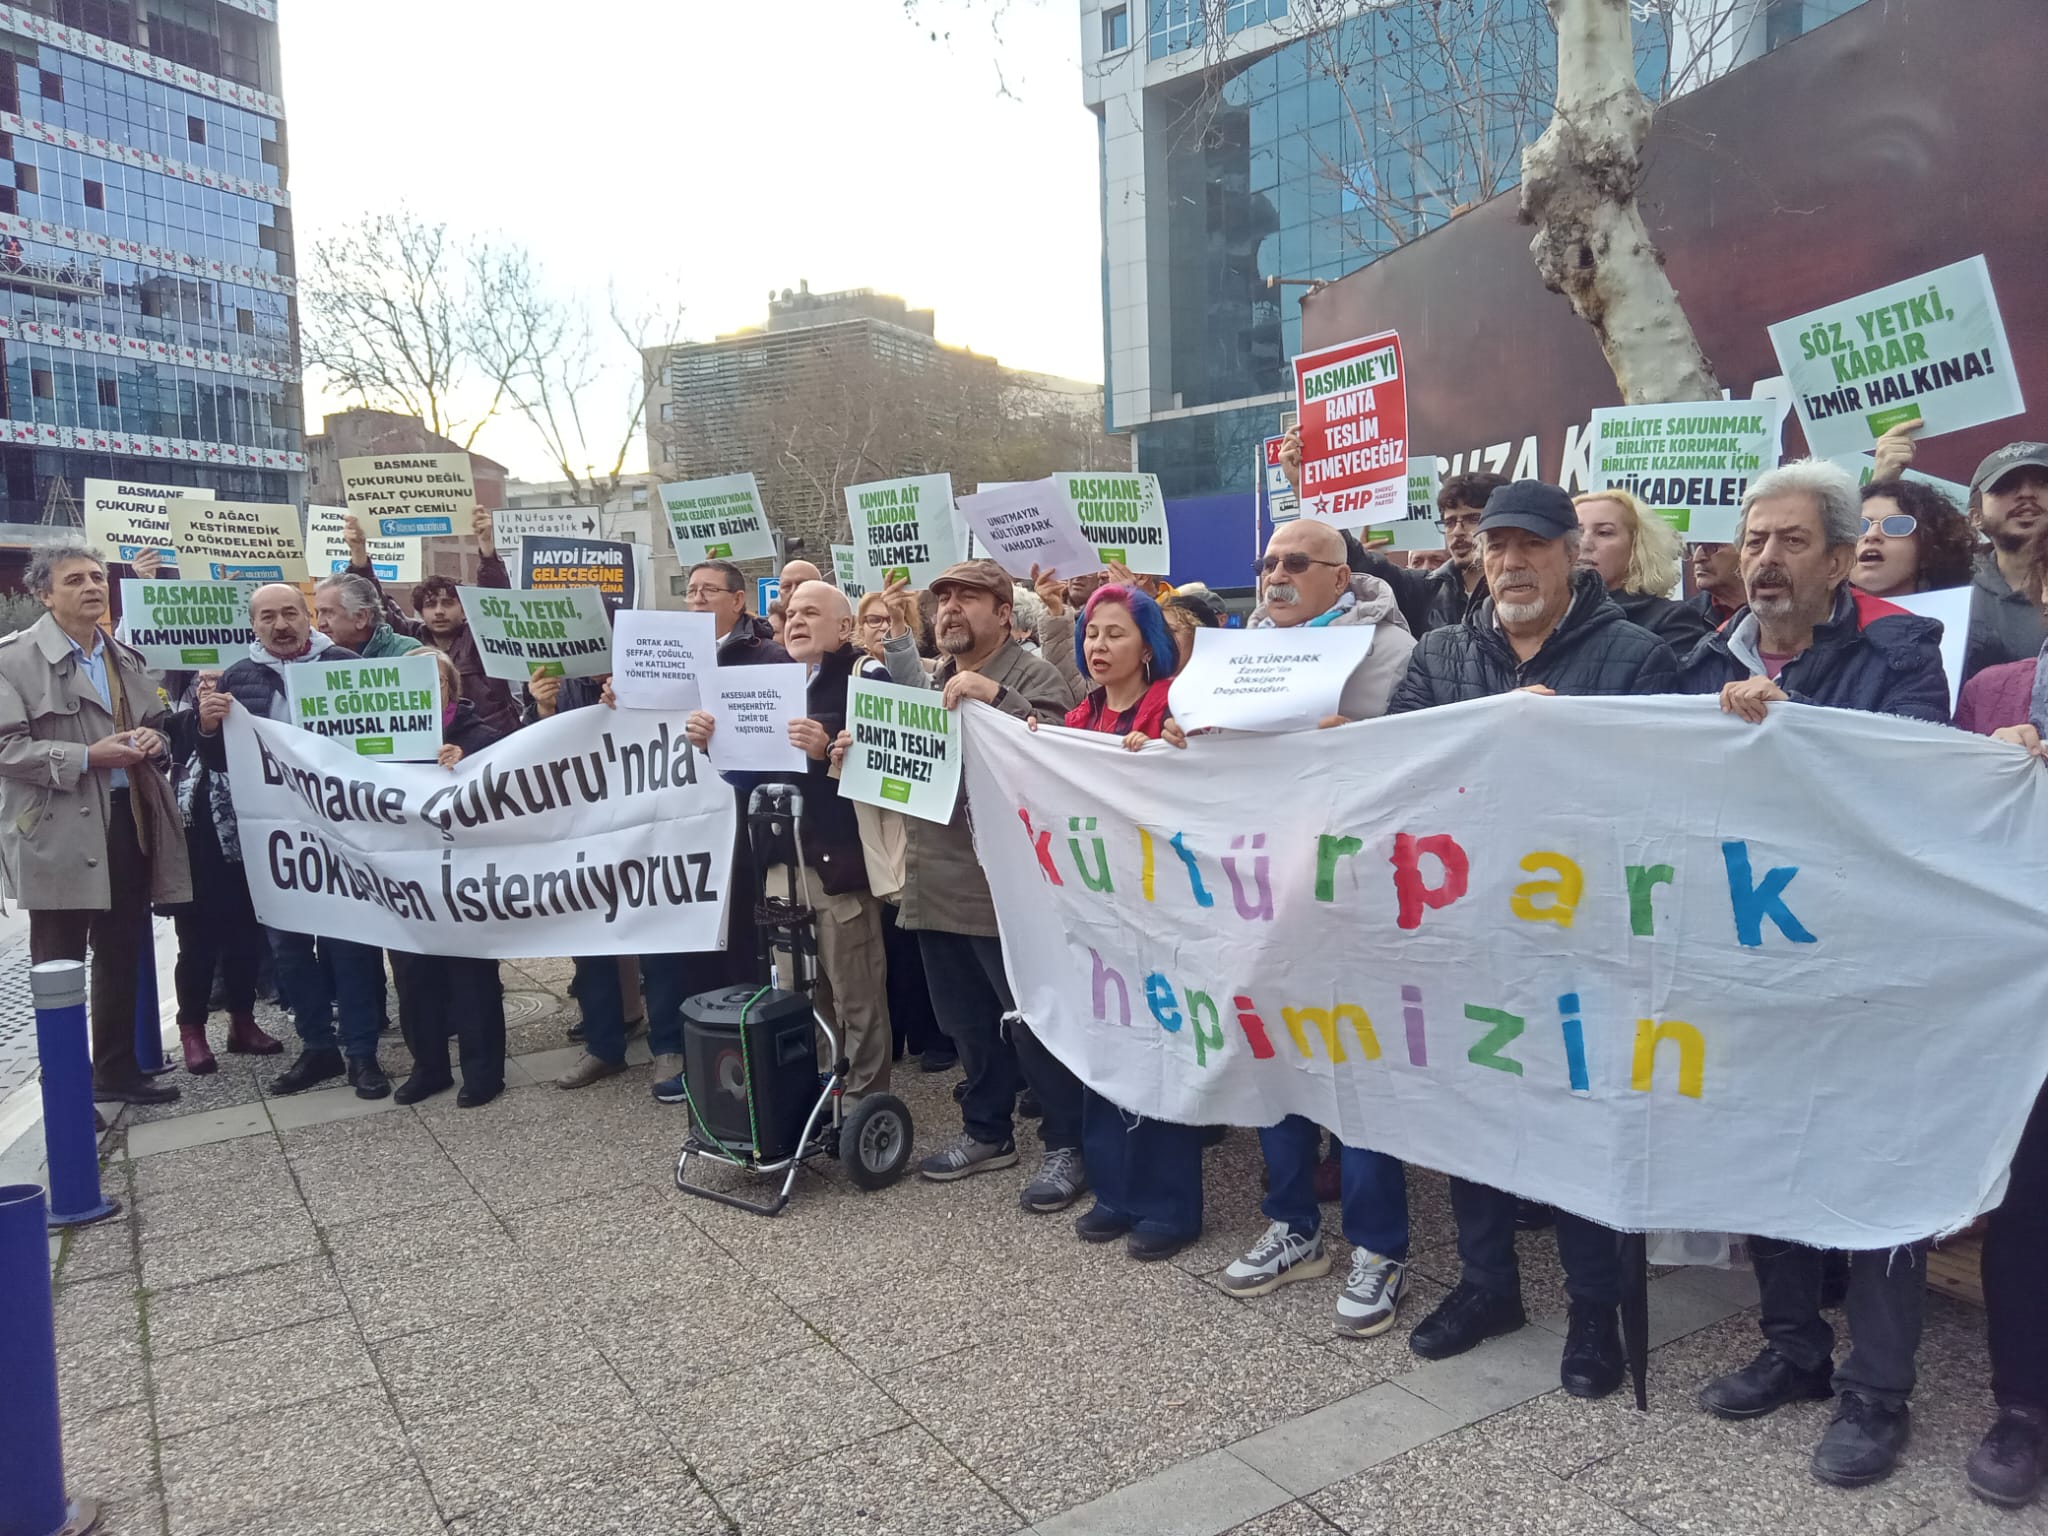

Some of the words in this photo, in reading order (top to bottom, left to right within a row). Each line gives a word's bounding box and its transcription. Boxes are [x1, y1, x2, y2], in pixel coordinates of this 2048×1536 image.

[1800, 322, 1853, 360] SÖZ,
[1856, 285, 1954, 342] YETKİ,
[1831, 332, 1929, 384] KARAR
[1304, 347, 1396, 399] BASMANE'Yİ
[1802, 385, 1863, 421] İZMİR
[1864, 348, 1995, 407] HALKINA!
[1325, 389, 1376, 422] RANTA
[1324, 416, 1378, 451] TESLİM
[1600, 417, 1662, 439] BİRLİKTE
[1666, 415, 1766, 436] SAVUNMAK,
[1615, 438, 1665, 455] BİRLİKTE
[1669, 437, 1741, 454] KORUMAK,
[374, 459, 438, 470] BASMANE
[1304, 438, 1404, 485] ETMEYECEĞİZ
[1601, 455, 1648, 472] BİRLİKTE
[1651, 455, 1727, 470] KAZANMAK
[1730, 453, 1759, 472] İÇİN
[347, 474, 423, 488] ÇUKURUNU
[426, 472, 465, 483] DEĞİL
[1069, 479, 1143, 501] BASMANE
[117, 485, 184, 498] BASMANE
[347, 491, 395, 501] ASFALT
[399, 488, 473, 501] ÇUKURUNU
[859, 489, 898, 509] KAMUYA
[901, 484, 920, 504] AİT
[1332, 489, 1373, 513] EHP
[96, 500, 155, 513] ÇUKURU
[204, 510, 214, 519] O
[218, 509, 260, 522] AĞACI
[368, 505, 411, 515] KAPAT
[414, 504, 458, 513] CEMİL!
[718, 503, 754, 517] ALANINA
[867, 505, 917, 526] OLANDAN
[986, 506, 1040, 527] UNUTMAYIN
[1077, 501, 1139, 526] ÇUKURU
[190, 521, 281, 535] KESTİRMEDİK
[675, 526, 690, 539] BU
[690, 523, 716, 539] KENT
[718, 516, 760, 536] BİZİM!
[867, 522, 919, 545] FERAGAT
[990, 518, 1054, 540] KÜLTÜRPARK
[184, 533, 194, 541] O
[197, 534, 273, 547] GÖKDELENİ
[277, 539, 296, 547] DE
[367, 540, 405, 549] TESLİM
[176, 546, 305, 559] YAPTIRMAYACAĞIZ!
[532, 547, 579, 565] HAYDİ
[581, 547, 624, 565] İZMİR
[867, 544, 930, 567] EDİLEMEZ!
[531, 565, 624, 583] GELECEĞİNE
[143, 585, 240, 605] BASMANE
[152, 606, 234, 629] ÇUKURU
[480, 596, 519, 620] SÖZ,
[520, 596, 583, 620] YETKİ,
[502, 620, 568, 639] KARAR
[480, 635, 524, 657] İZMİR
[526, 637, 608, 658] HALKINA!
[636, 638, 662, 646] ORTAK
[663, 639, 684, 648] AKIL,
[625, 648, 656, 658] ŞEFFAF,
[657, 649, 694, 660] ÇOĞULCU,
[645, 660, 686, 669] KATILIMCI
[1229, 653, 1322, 665] KÜLTÜRPARK
[325, 669, 352, 691] NE
[358, 667, 400, 689] AVM
[625, 669, 660, 678] YÖNETİM
[662, 671, 696, 680] NEREDE?
[1233, 676, 1286, 685] Oksijen
[720, 691, 757, 699] AKSESUAR
[757, 688, 782, 699] DEĞİL,
[1212, 685, 1290, 695] Deposudur.
[301, 696, 329, 717] NE
[334, 690, 432, 714] GÖKDELEN
[854, 692, 894, 723] KENT
[898, 700, 948, 734] HAKKI
[303, 716, 385, 737] KAMUSAL
[389, 714, 433, 732] ALAN!
[856, 723, 897, 750] RANTA
[900, 734, 946, 761] TESLİM
[866, 749, 933, 783] EDİLEMEZ!
[420, 722, 698, 842] Çukuru'nda
[440, 850, 718, 923] İstemiyoruz
[1087, 947, 1705, 1099] hepimizin
